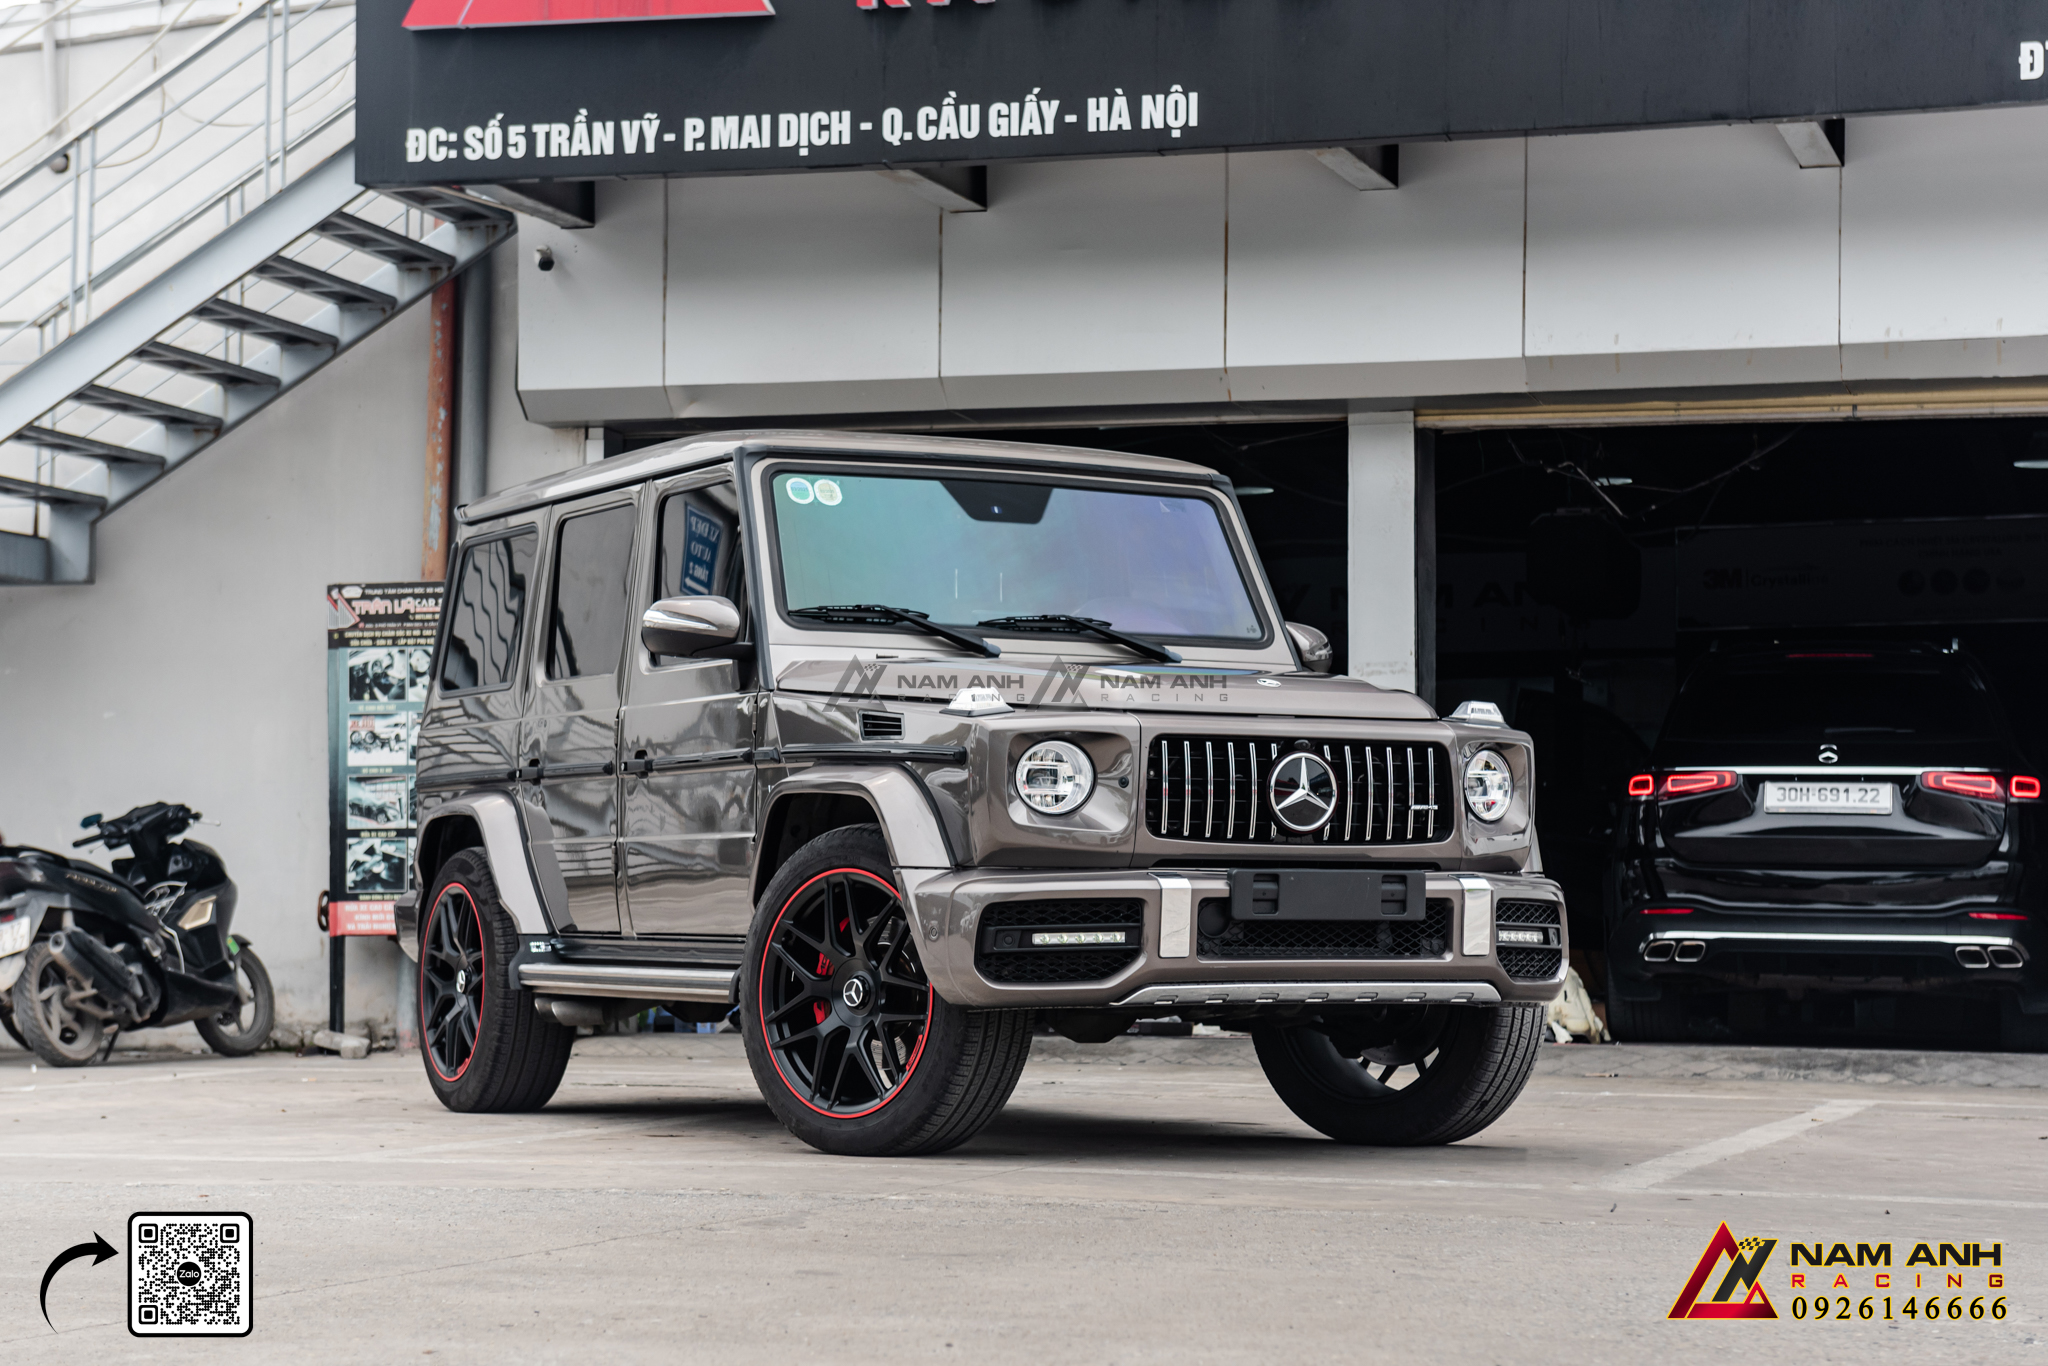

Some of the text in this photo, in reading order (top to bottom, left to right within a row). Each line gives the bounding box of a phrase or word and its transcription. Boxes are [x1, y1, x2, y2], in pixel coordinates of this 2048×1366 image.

[2018, 40, 2048, 81] Đ
[405, 127, 458, 163] ĐC:
[463, 112, 505, 161] SỐ
[507, 125, 527, 159] 5
[531, 108, 615, 158] TRẦN
[620, 112, 661, 155] VỸ
[778, 110, 851, 157] DỊCH
[988, 87, 1060, 138] GIẤY
[1087, 87, 1132, 133] HÀ
[1141, 84, 1199, 138] NỘI
